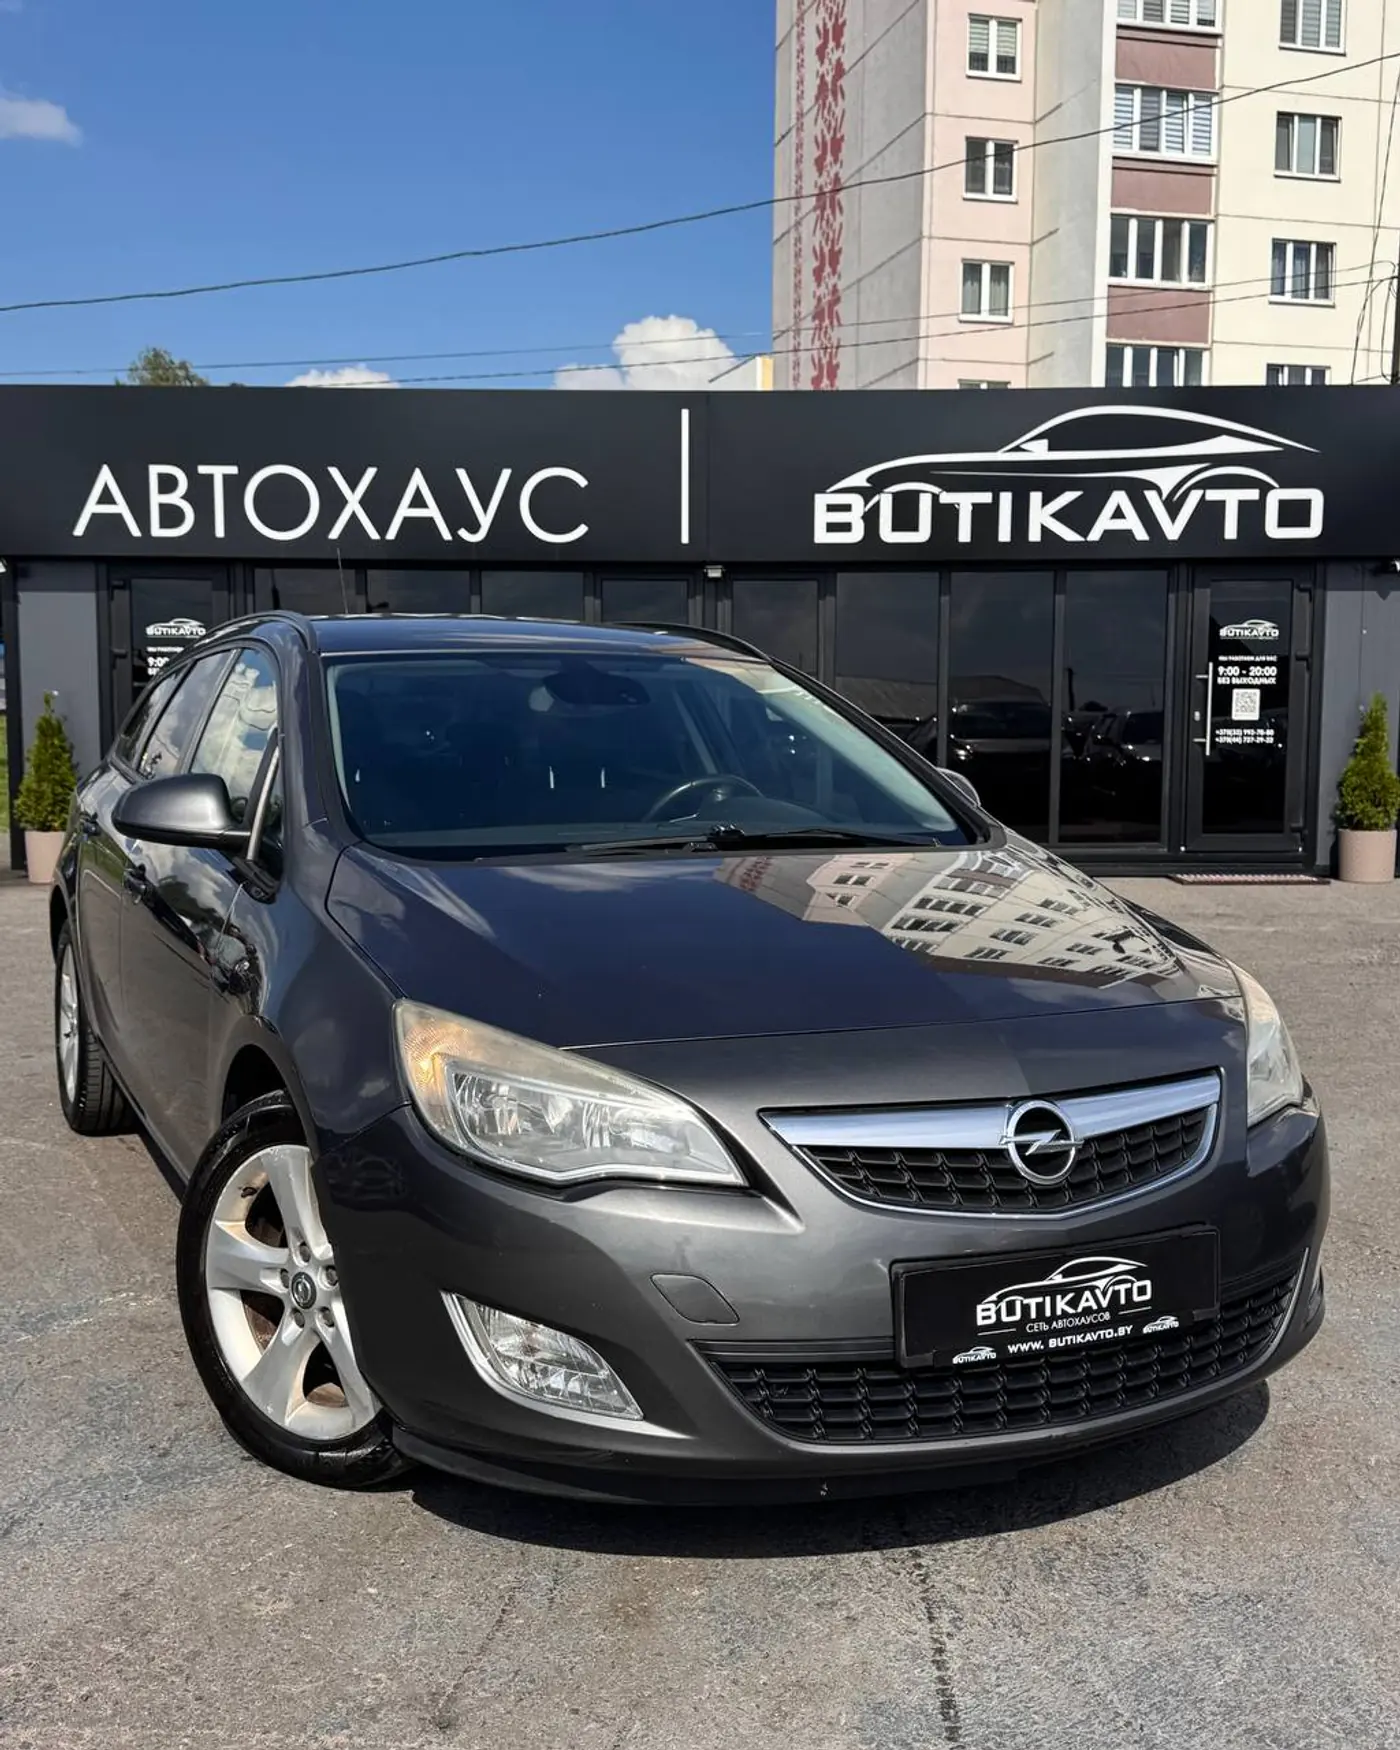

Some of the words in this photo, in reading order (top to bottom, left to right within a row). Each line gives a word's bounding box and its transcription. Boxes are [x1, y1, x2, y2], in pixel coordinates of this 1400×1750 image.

[72, 463, 589, 543] АВТОХАУС
[813, 487, 1325, 544] BUTIKAVTO
[1217, 665, 1240, 676] 9:00
[1248, 665, 1277, 676] 20:00
[976, 1279, 1152, 1326] BUTIKAVTO
[1007, 1340, 1045, 1354] WWW.
[1048, 1324, 1133, 1348] BUTIKAVTO.BY
[1025, 1321, 1049, 1333] СЕТЬ
[1051, 1311, 1111, 1330] АВТОХАУСОВ
